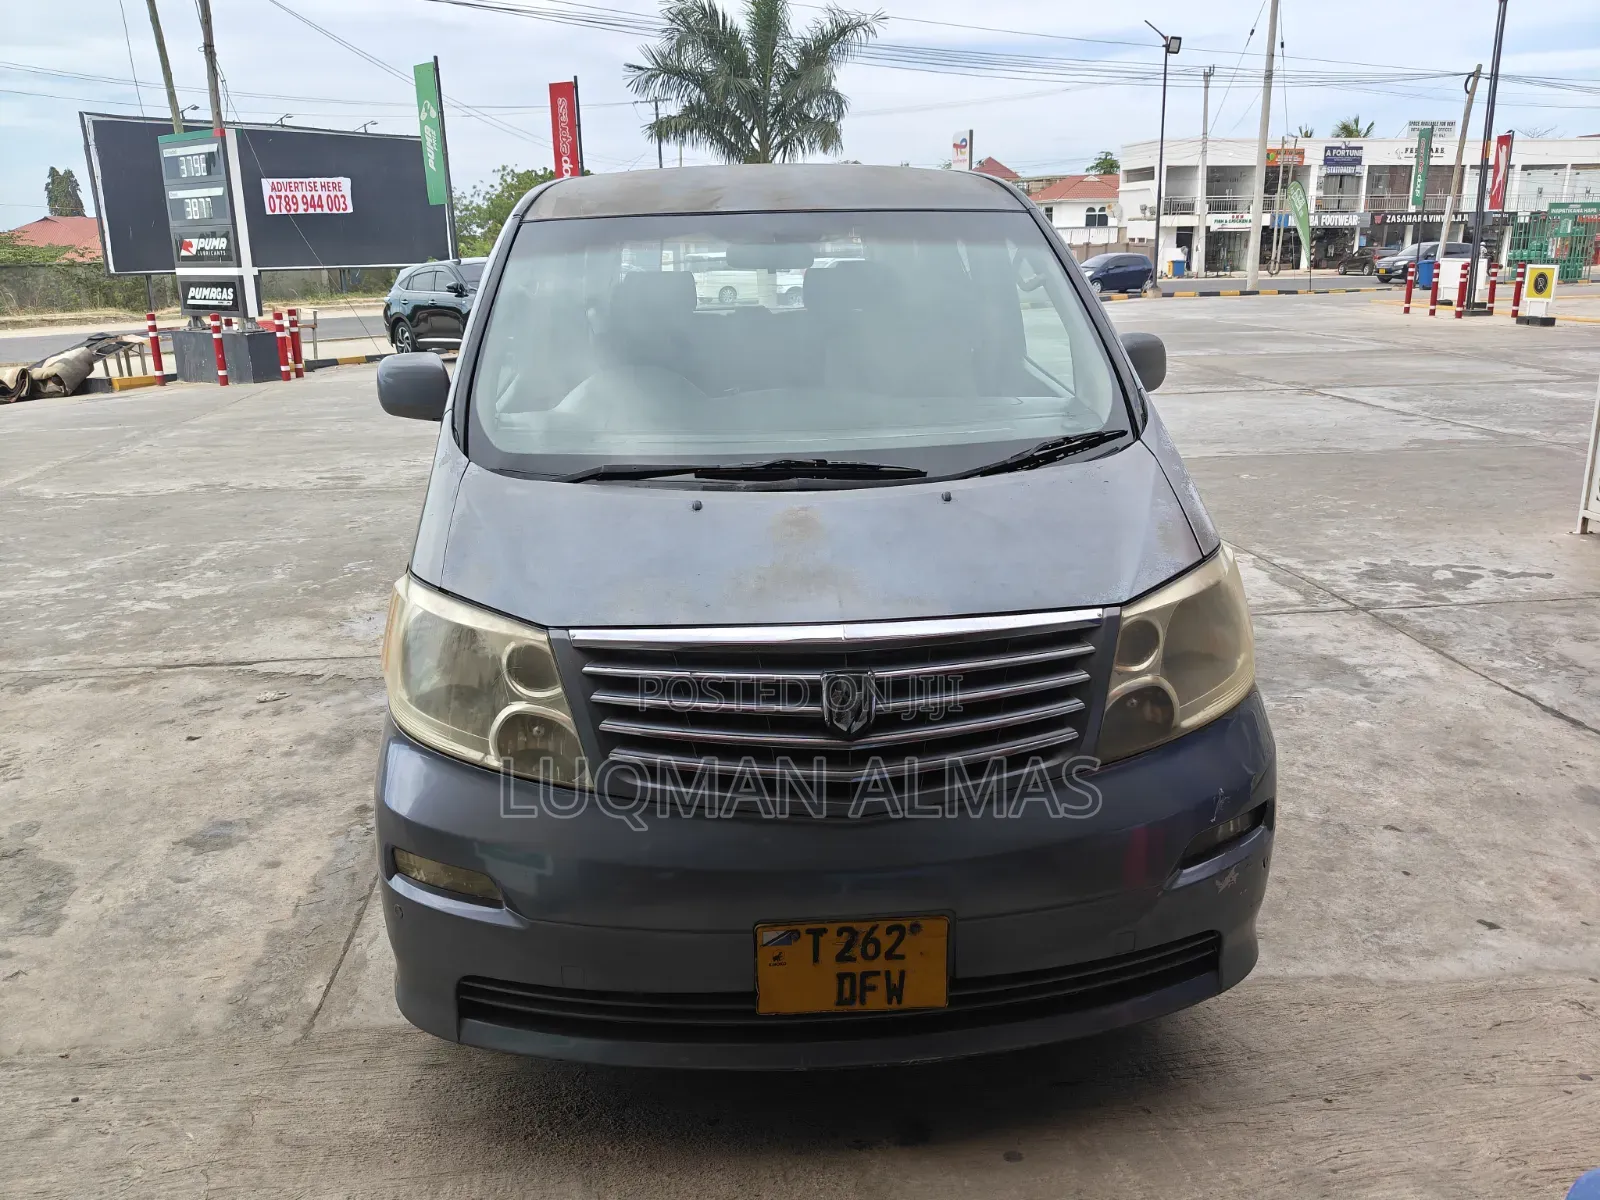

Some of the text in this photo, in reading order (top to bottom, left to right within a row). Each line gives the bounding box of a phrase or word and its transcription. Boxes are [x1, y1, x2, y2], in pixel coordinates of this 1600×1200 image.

[556, 97, 573, 156] express
[424, 124, 436, 172] PUMA
[271, 182, 342, 192] ADVERTISE HERE
[268, 194, 348, 213] 0789 944 003
[1429, 214, 1462, 222] VINYAJI
[198, 238, 227, 250] PUMA
[188, 287, 234, 300] PUMAGAS
[805, 924, 906, 964] T 262
[835, 970, 906, 1006] DFW
